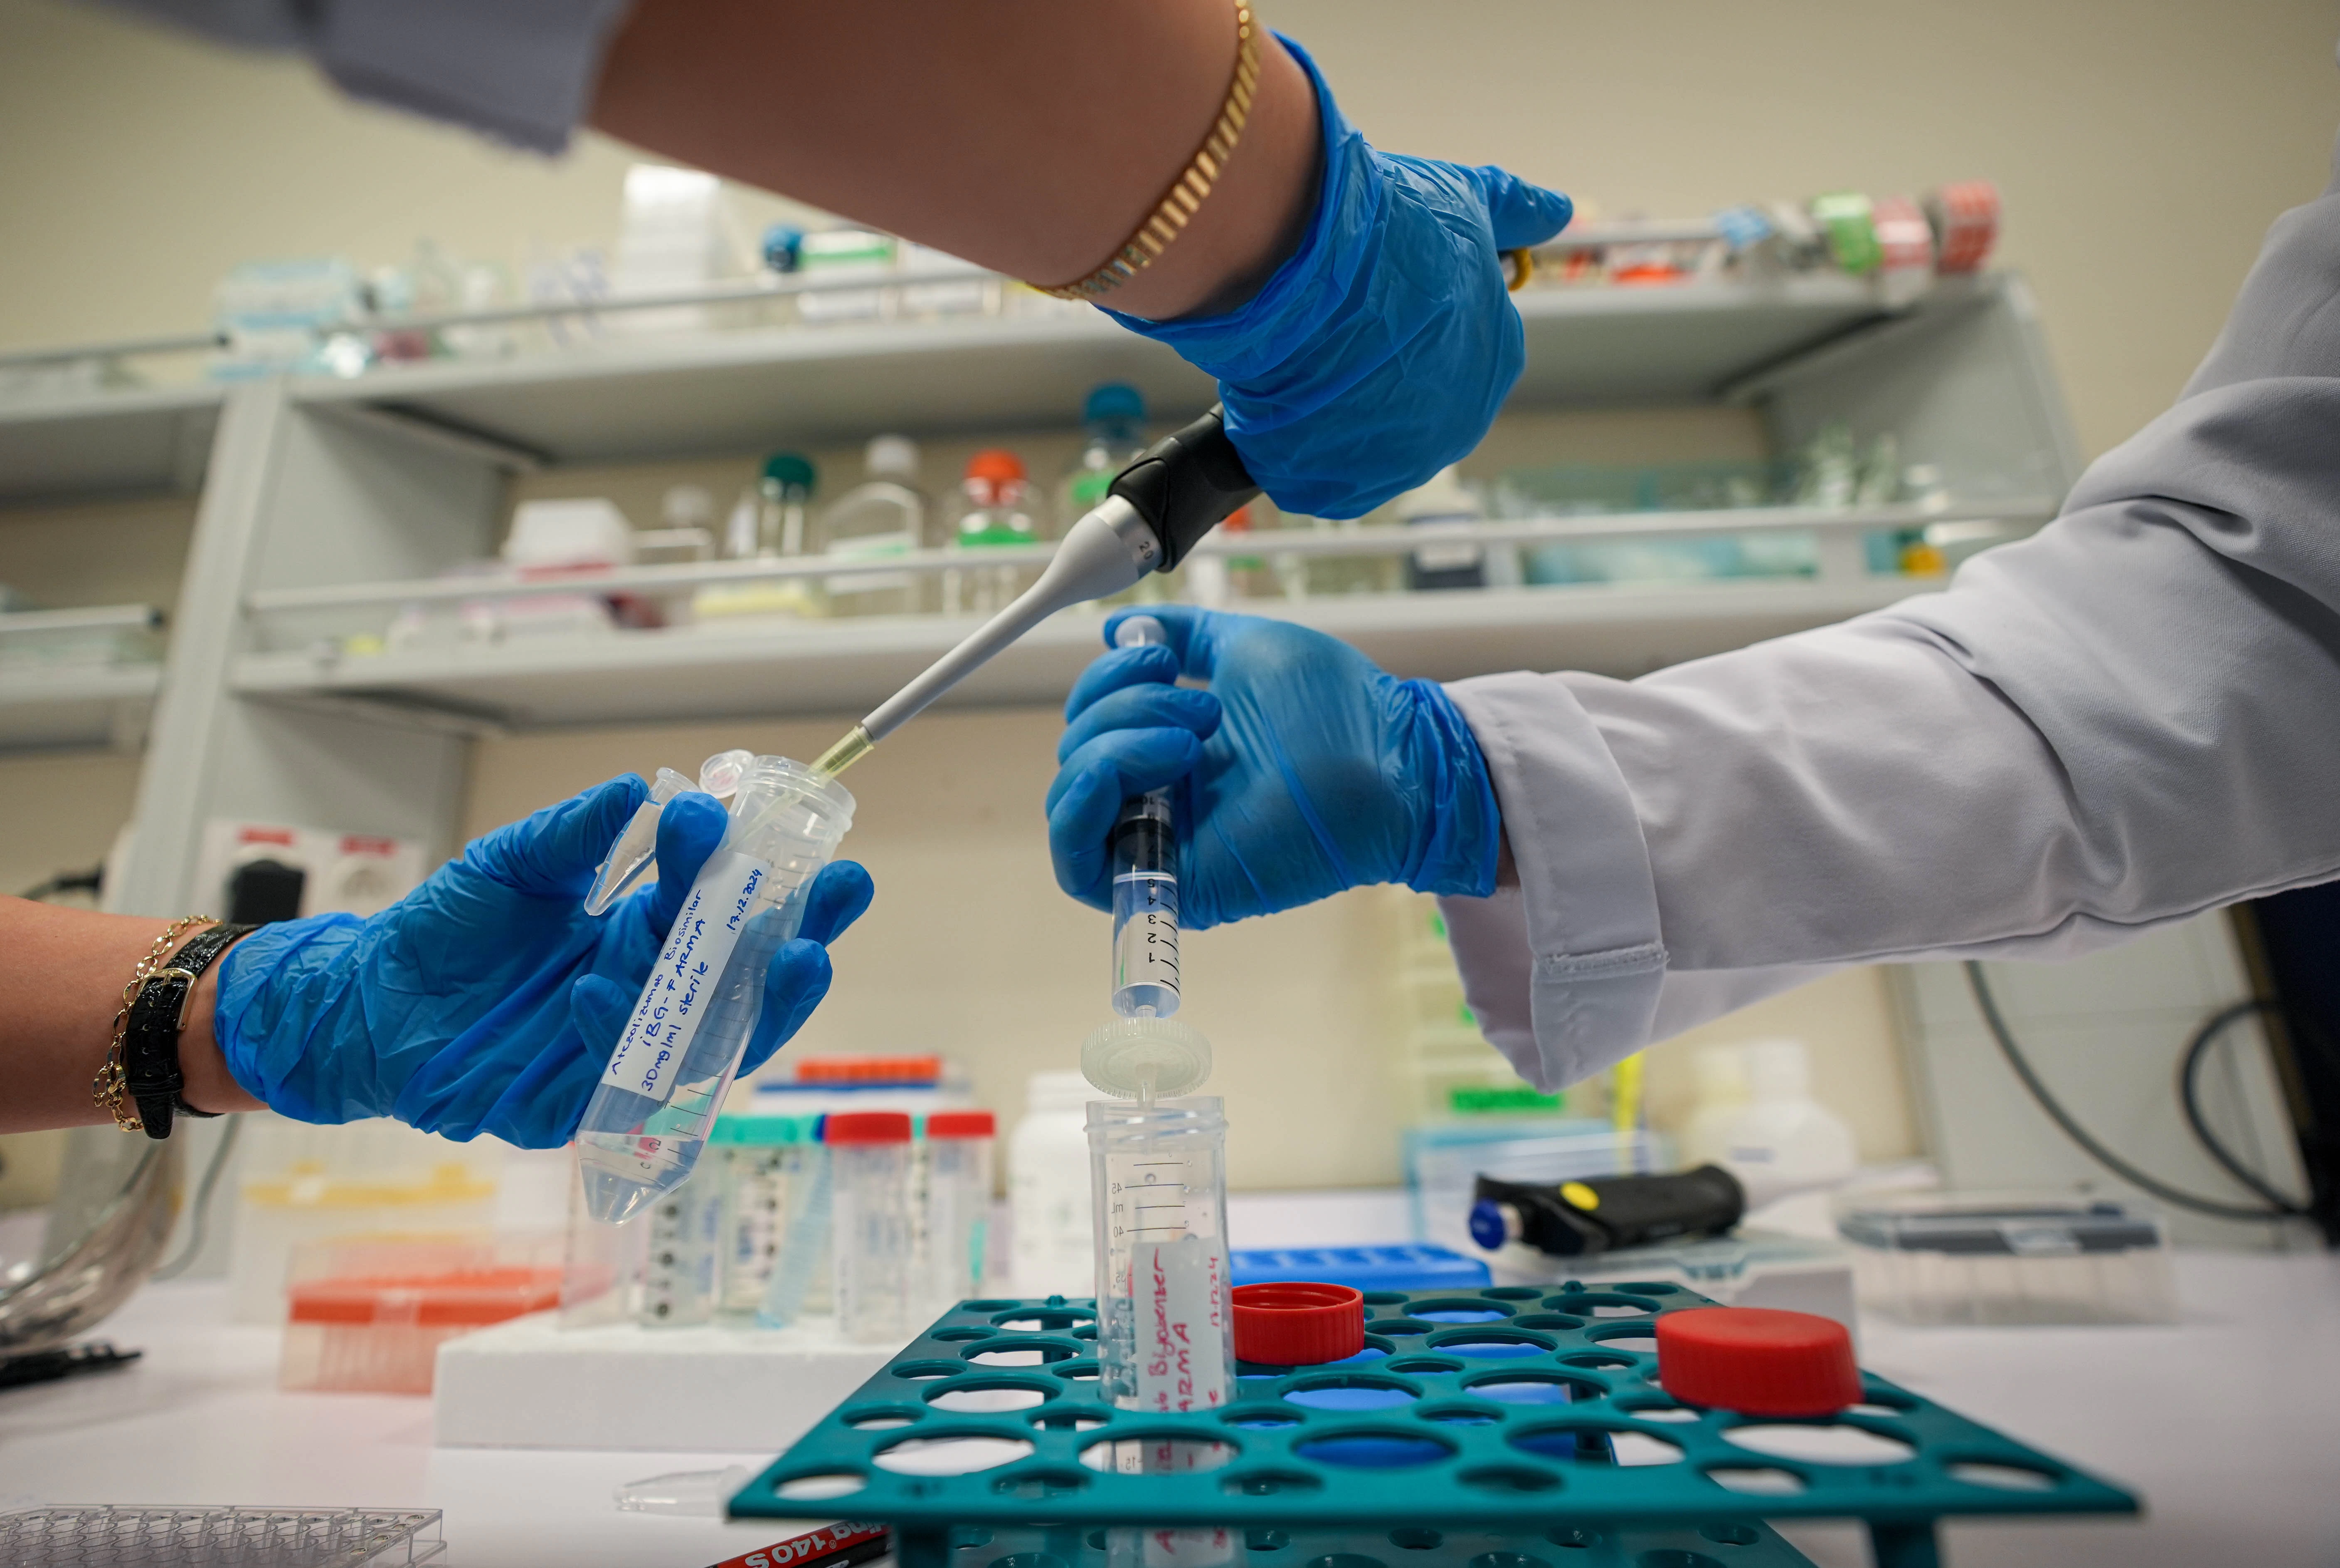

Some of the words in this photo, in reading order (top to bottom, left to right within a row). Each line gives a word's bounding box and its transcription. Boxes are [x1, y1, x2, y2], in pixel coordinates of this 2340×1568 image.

[1147, 878, 1156, 888] 5
[726, 868, 763, 931] 17.12.2024
[1147, 896, 1157, 905] 4
[665, 889, 702, 961] Biosimilar
[1147, 914, 1156, 925] 3
[1147, 933, 1156, 944] 2
[1149, 952, 1155, 963] 1
[678, 960, 709, 1016] sterile
[771, 1534, 826, 1563] 140
